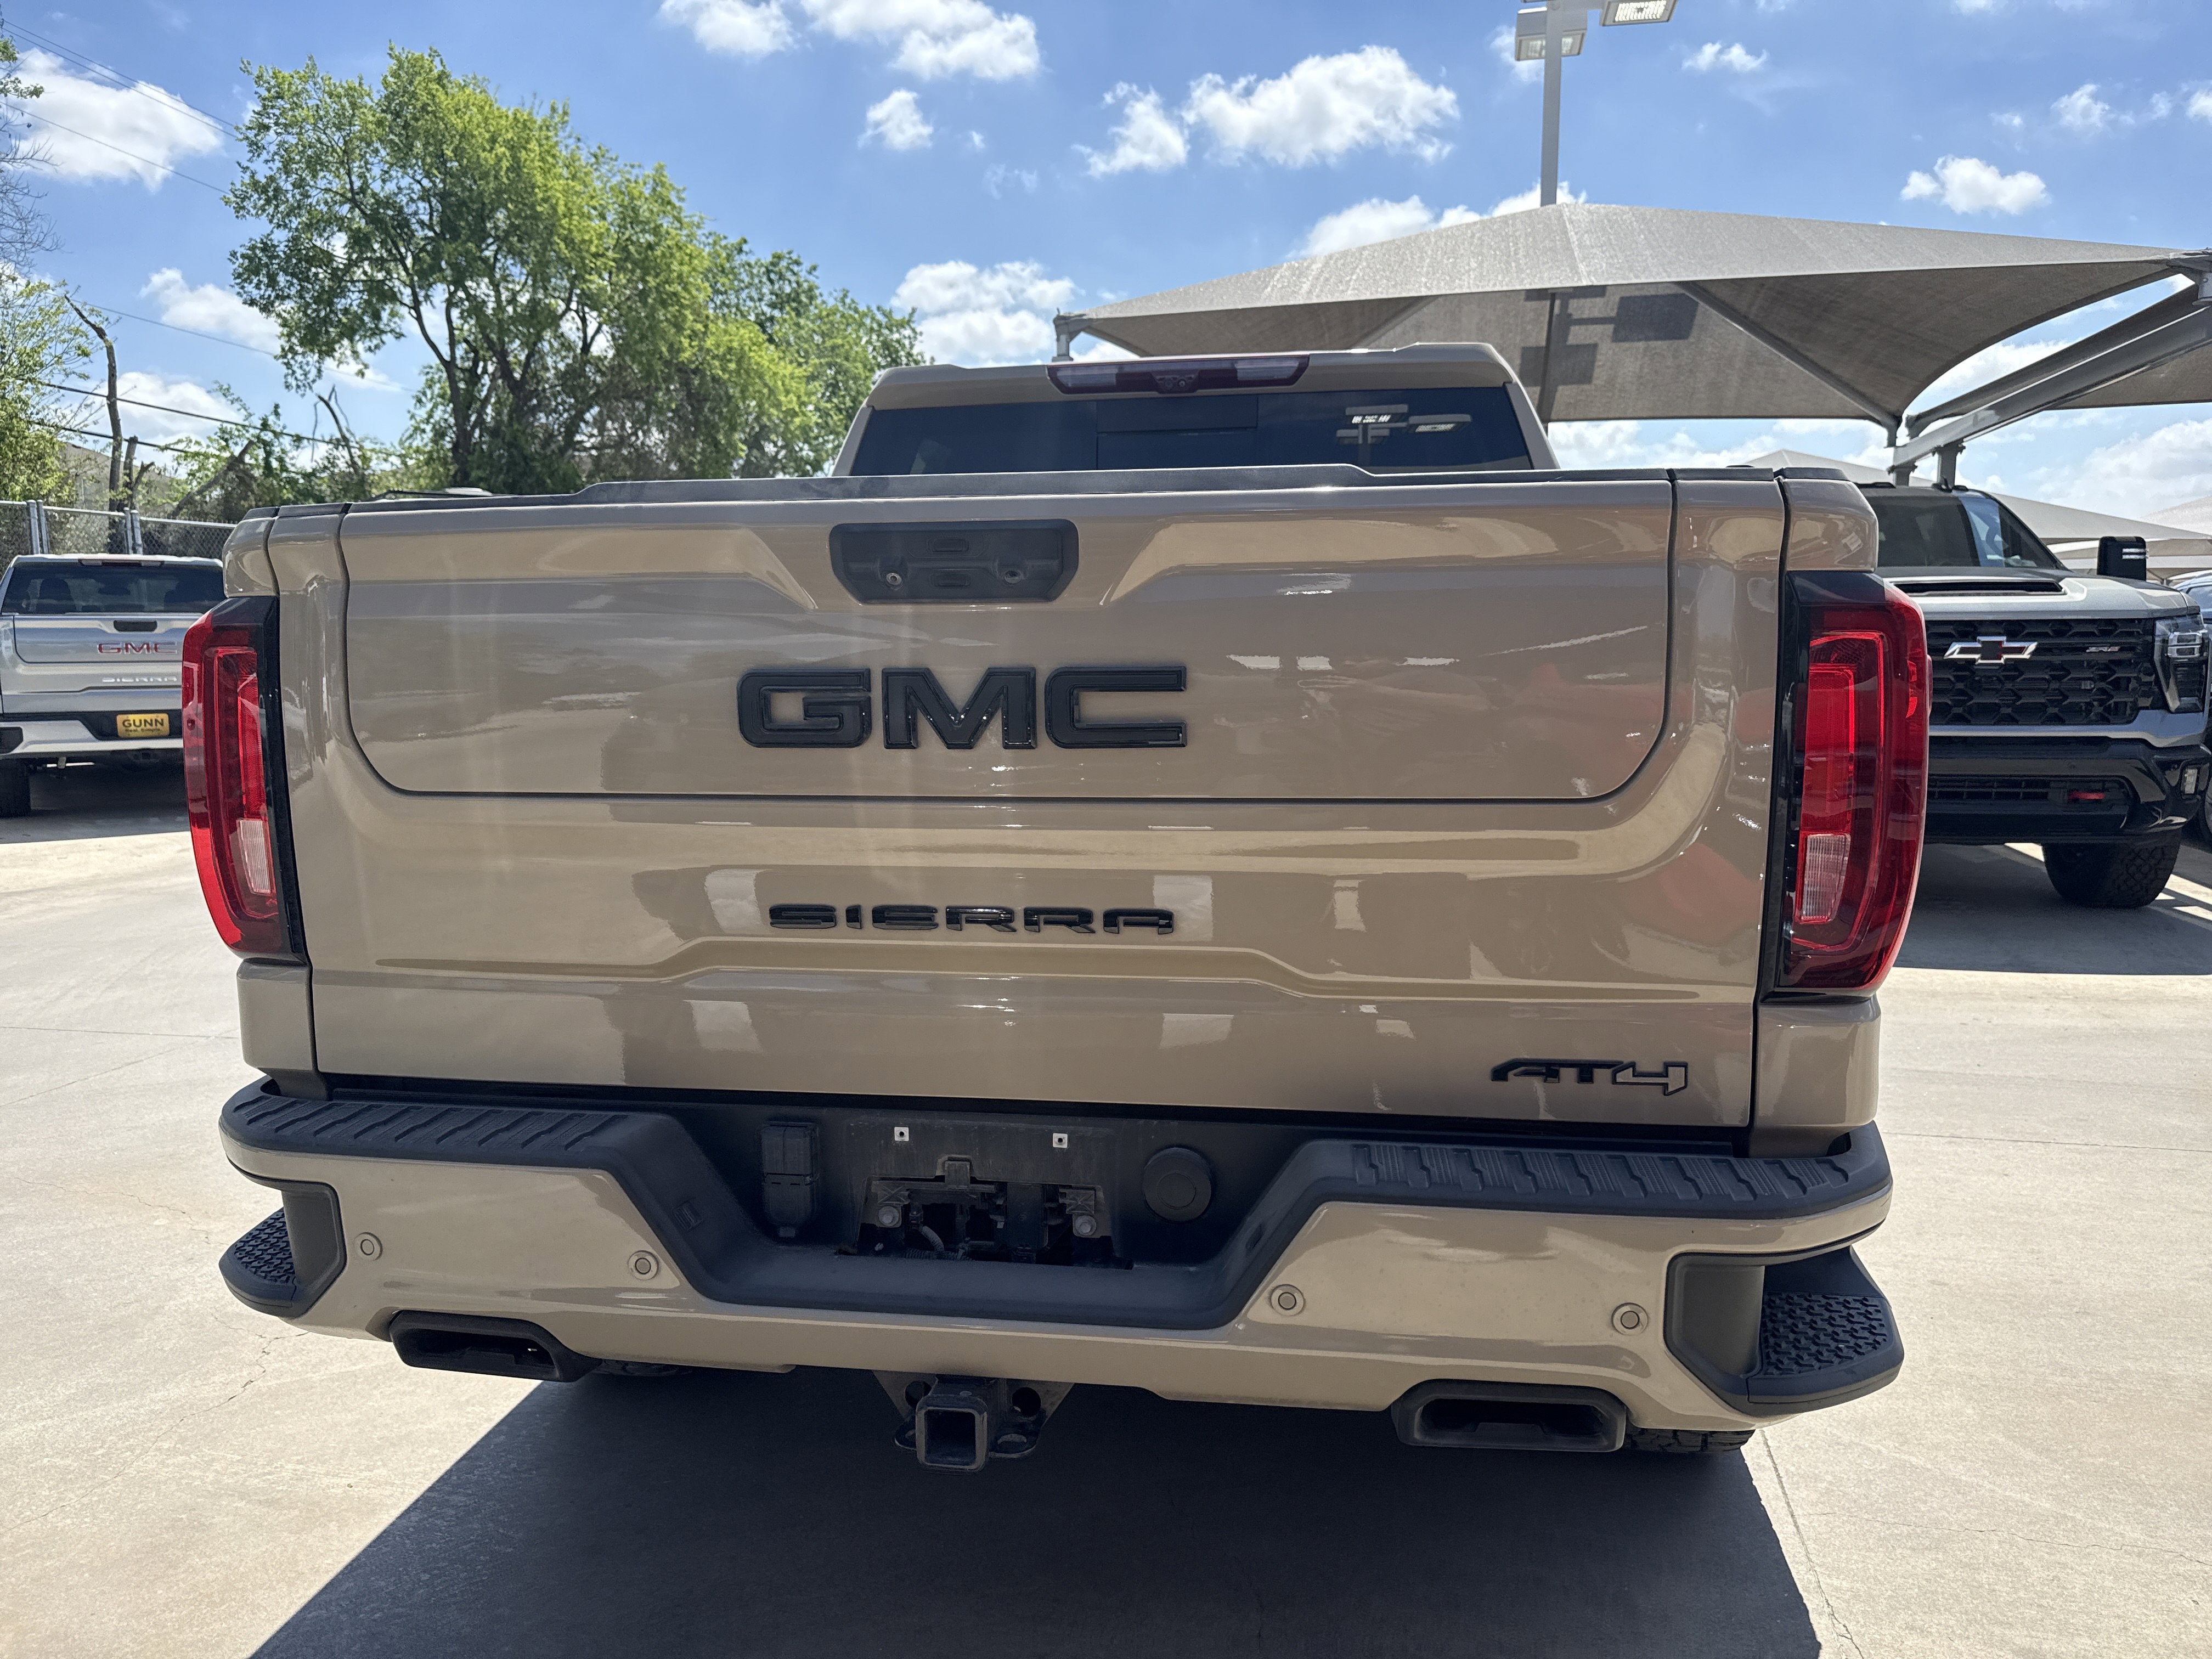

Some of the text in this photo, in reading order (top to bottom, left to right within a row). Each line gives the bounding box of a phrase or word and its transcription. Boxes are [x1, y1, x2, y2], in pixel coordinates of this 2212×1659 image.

[97, 641, 178, 654] GMC
[737, 665, 1187, 749] GMC
[122, 718, 164, 728] GUNN
[769, 905, 1175, 935] SIERRA
[1491, 1058, 1688, 1096] AT4
